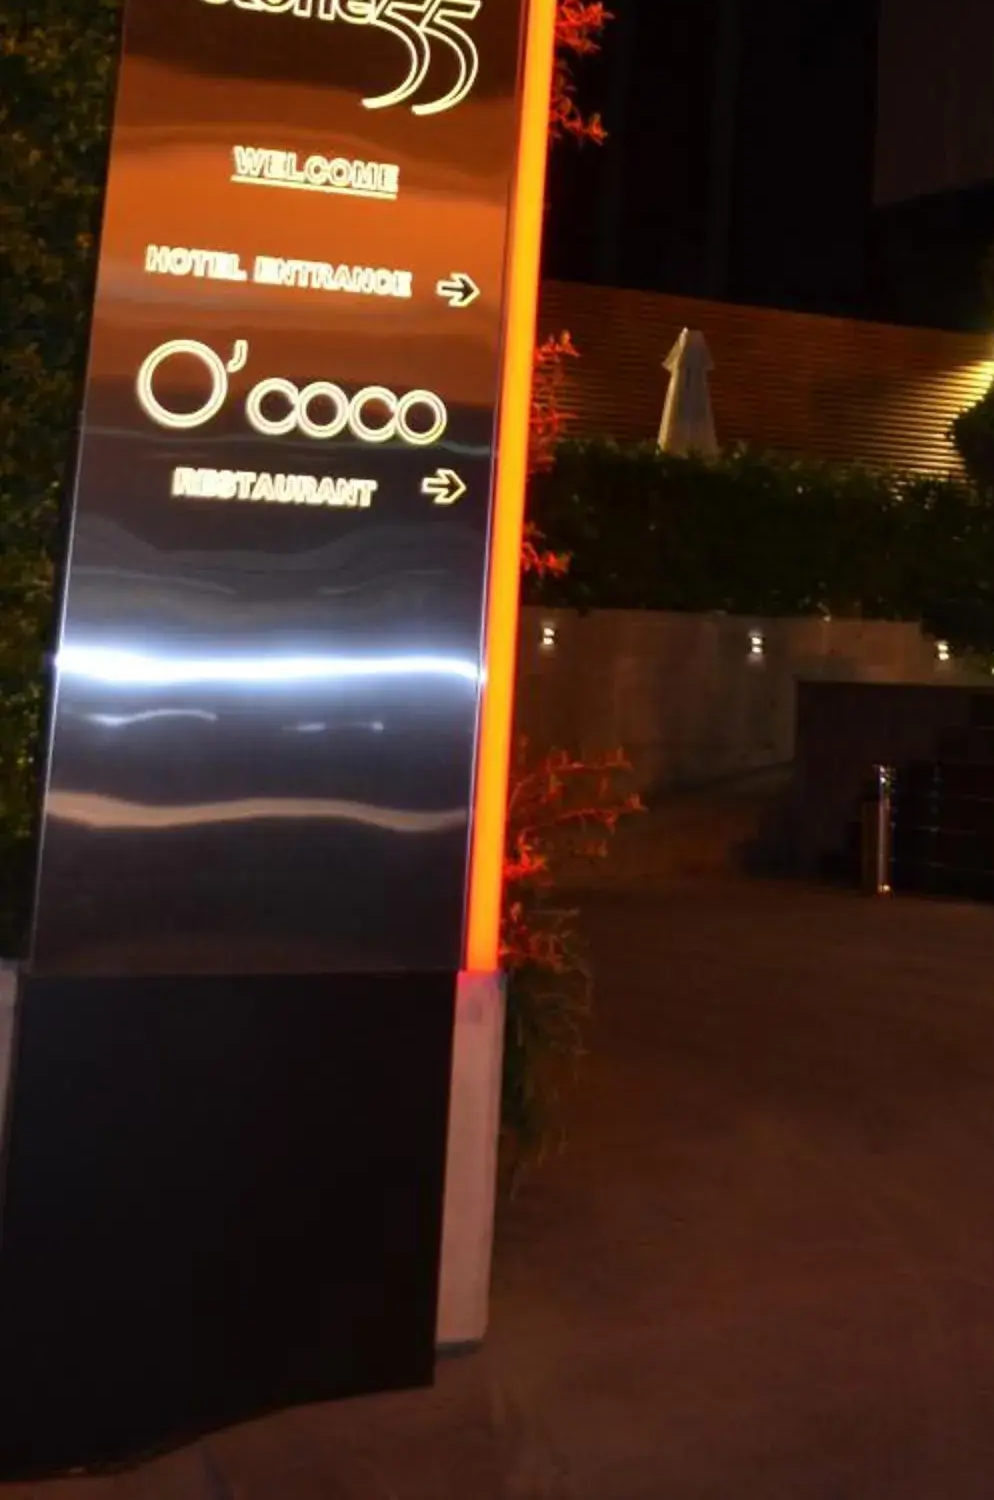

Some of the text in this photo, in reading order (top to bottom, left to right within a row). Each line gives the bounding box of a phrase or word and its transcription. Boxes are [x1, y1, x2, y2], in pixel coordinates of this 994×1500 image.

[232, 145, 400, 199] WELCOME
[145, 245, 413, 298] HOTEL ENTRANCE
[171, 466, 378, 507] RESTAURANT
